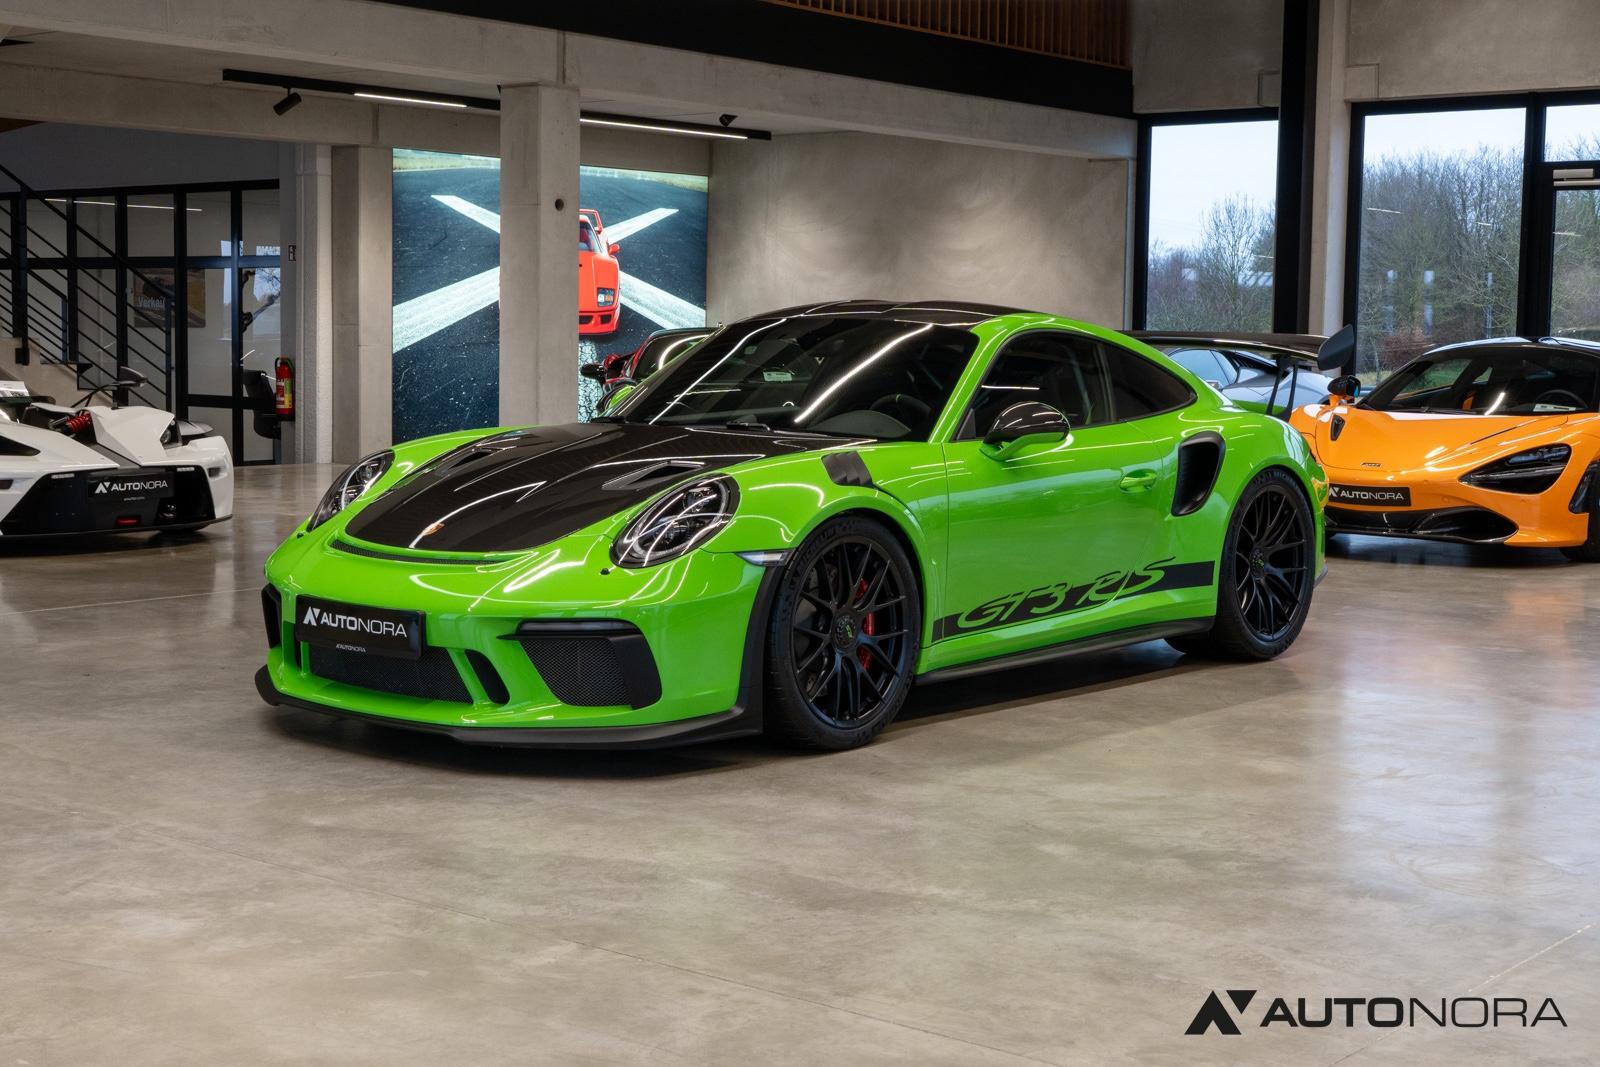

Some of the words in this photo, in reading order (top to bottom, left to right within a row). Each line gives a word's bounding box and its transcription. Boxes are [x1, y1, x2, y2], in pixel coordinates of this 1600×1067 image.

[111, 480, 168, 491] AUTONORA
[1340, 490, 1404, 500] AUTONORA
[957, 583, 1072, 628] GT3
[1076, 556, 1176, 605] RS
[320, 612, 407, 638] AUTONORA
